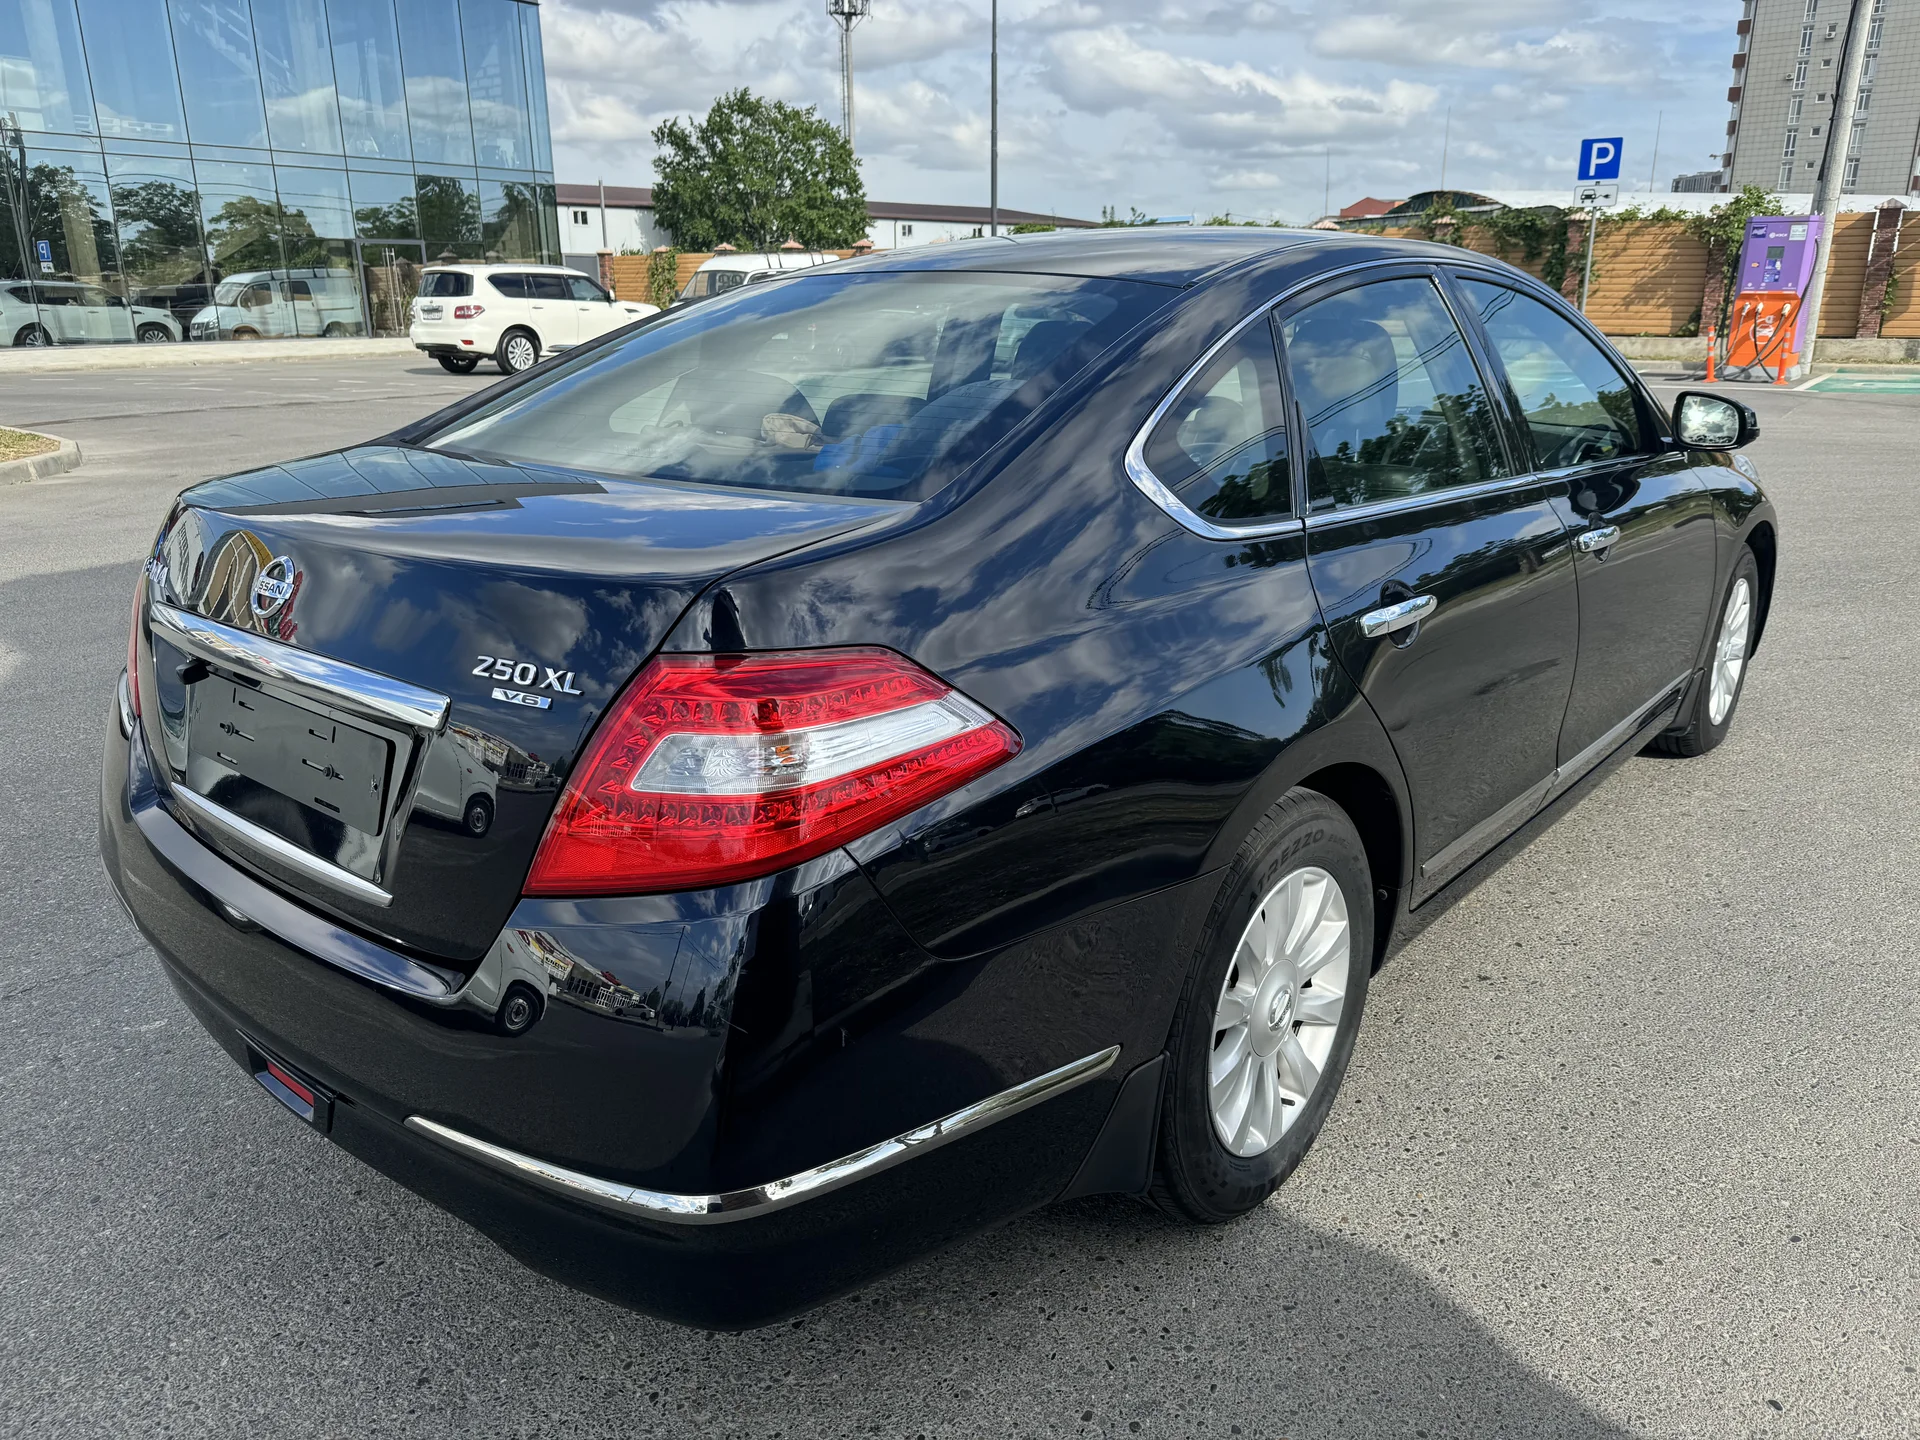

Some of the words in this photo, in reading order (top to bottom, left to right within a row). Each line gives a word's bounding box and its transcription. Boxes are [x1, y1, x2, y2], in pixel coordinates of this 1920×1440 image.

[1588, 142, 1615, 177] P
[471, 655, 537, 686] 250
[538, 666, 584, 696] XL
[502, 690, 540, 706] V6
